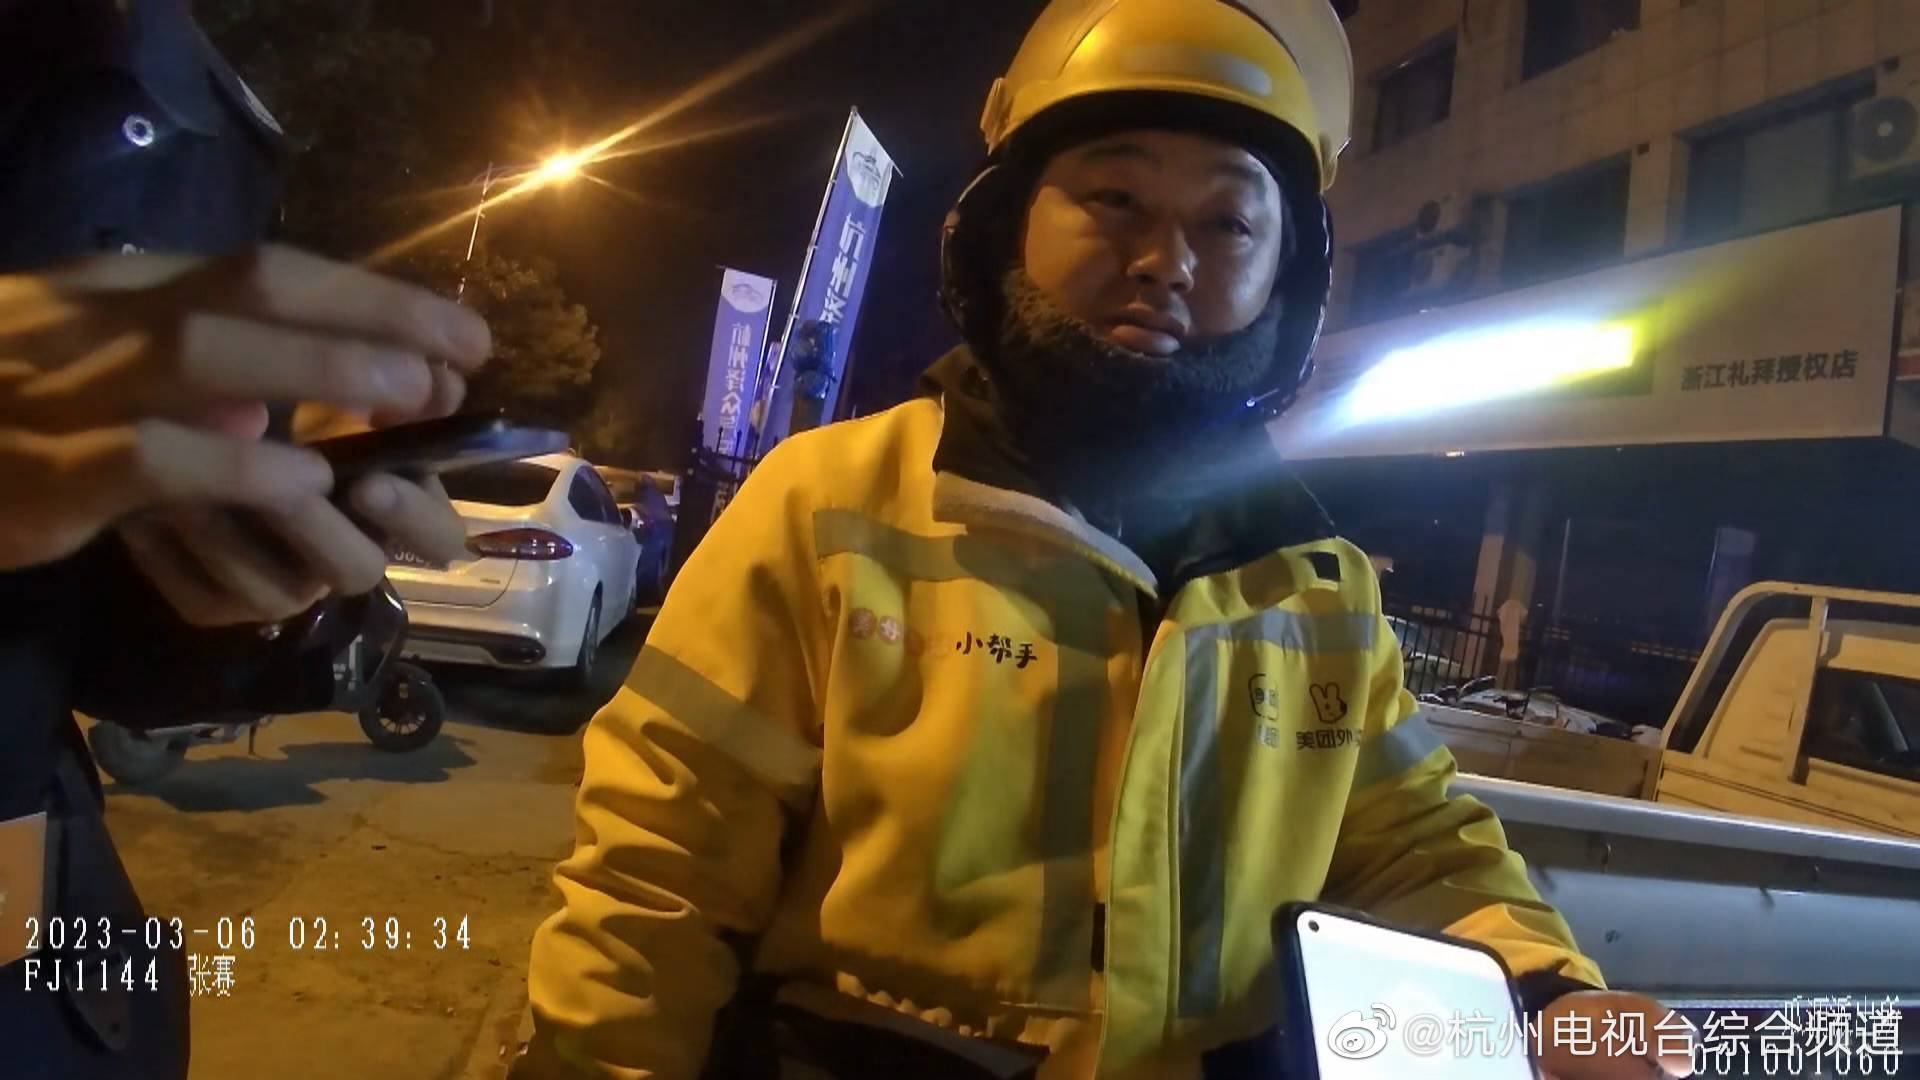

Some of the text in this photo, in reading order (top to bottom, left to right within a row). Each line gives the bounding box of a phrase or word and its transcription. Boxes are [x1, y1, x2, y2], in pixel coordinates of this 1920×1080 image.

[1681, 349, 1858, 391] 浙江礼拜授权店
[956, 631, 1037, 668] 小帮手
[1296, 728, 1362, 750] 美团外
